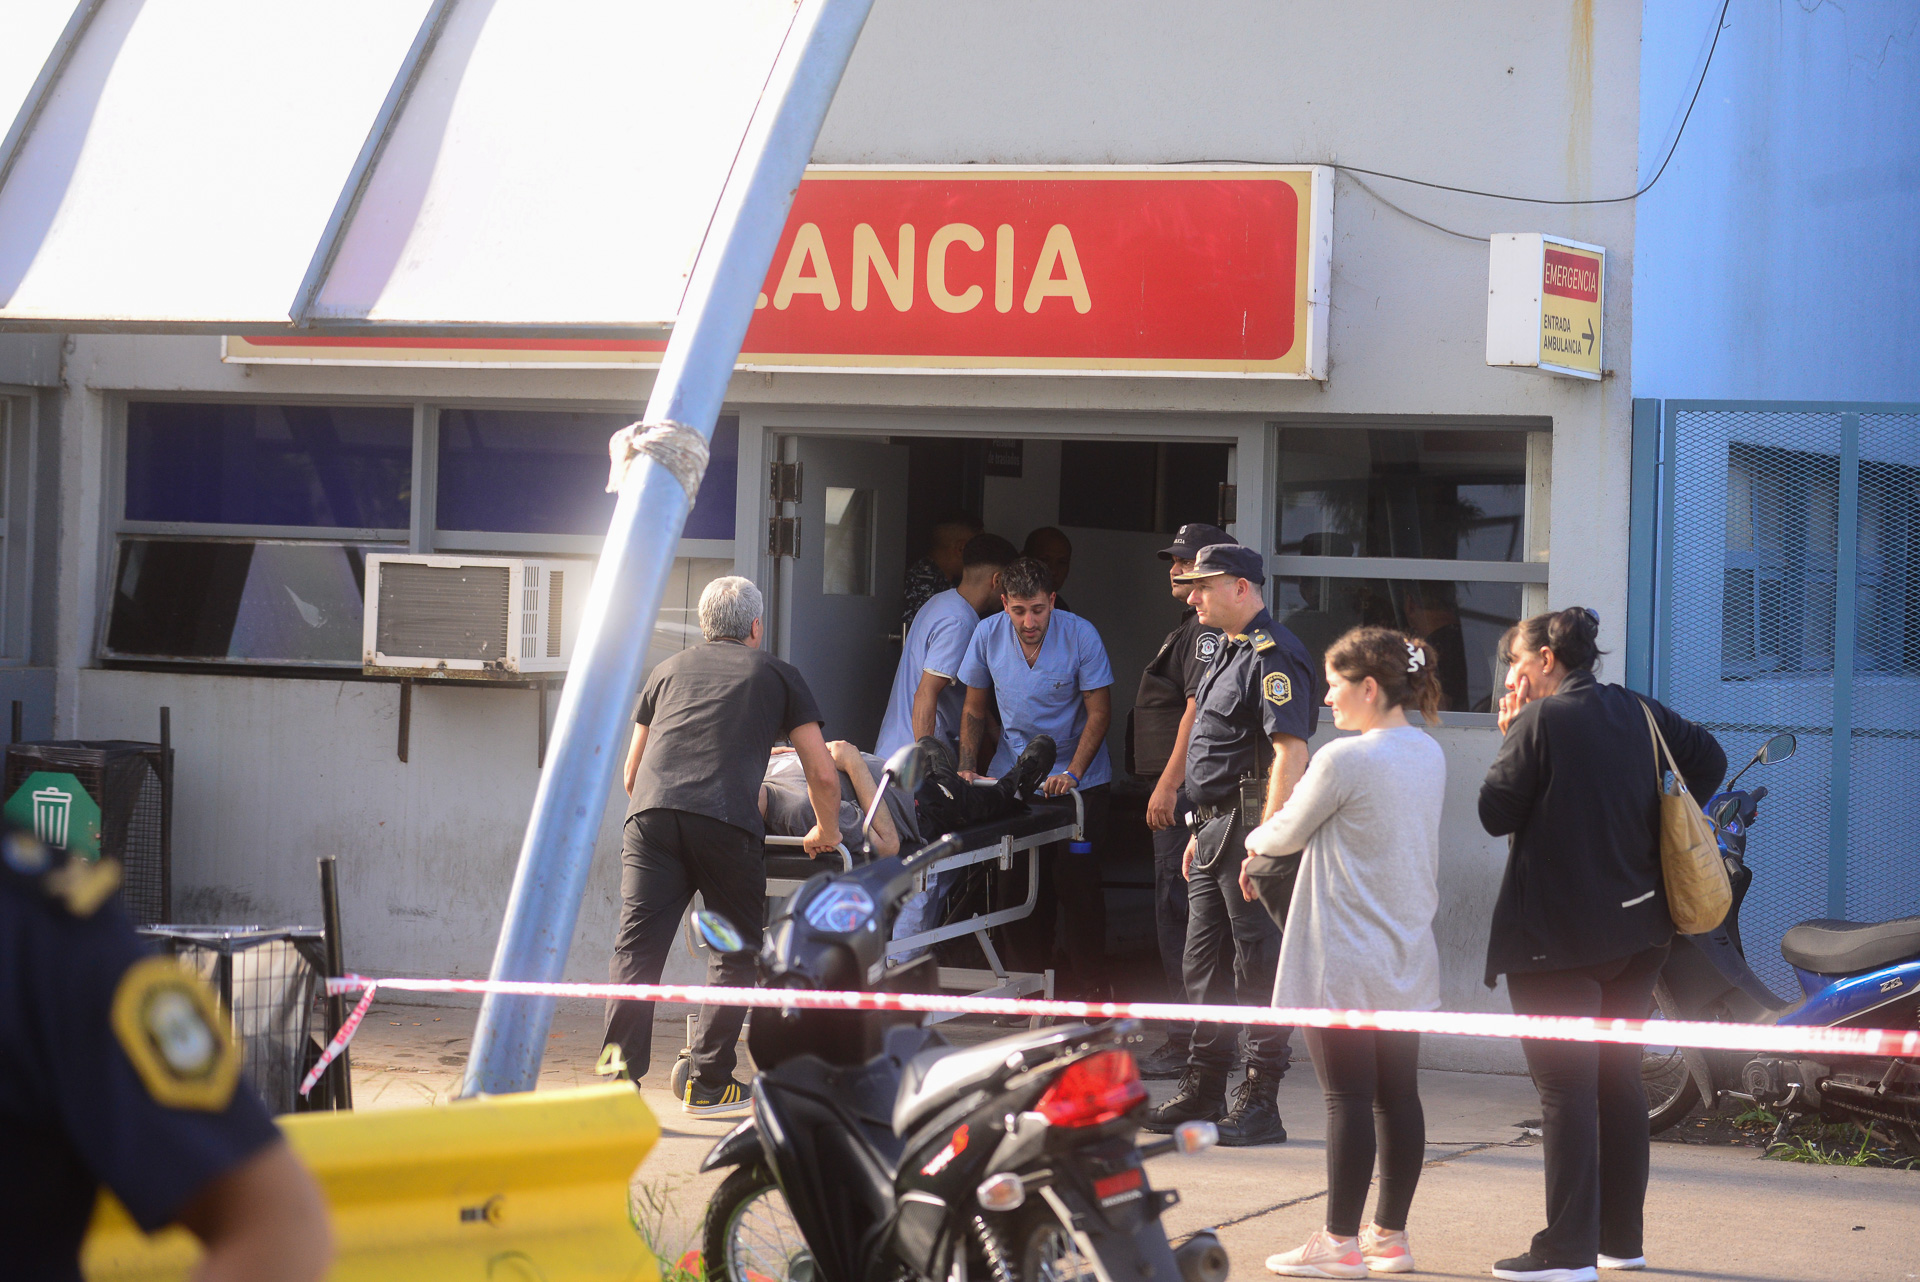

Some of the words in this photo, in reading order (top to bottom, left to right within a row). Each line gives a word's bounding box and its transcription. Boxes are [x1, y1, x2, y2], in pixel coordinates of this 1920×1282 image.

[755, 222, 1092, 315] ANCIA
[1545, 263, 1596, 293] EMERGENCIA
[1544, 314, 1571, 333] ENTRADA
[1544, 335, 1582, 355] AMBULANCIA
